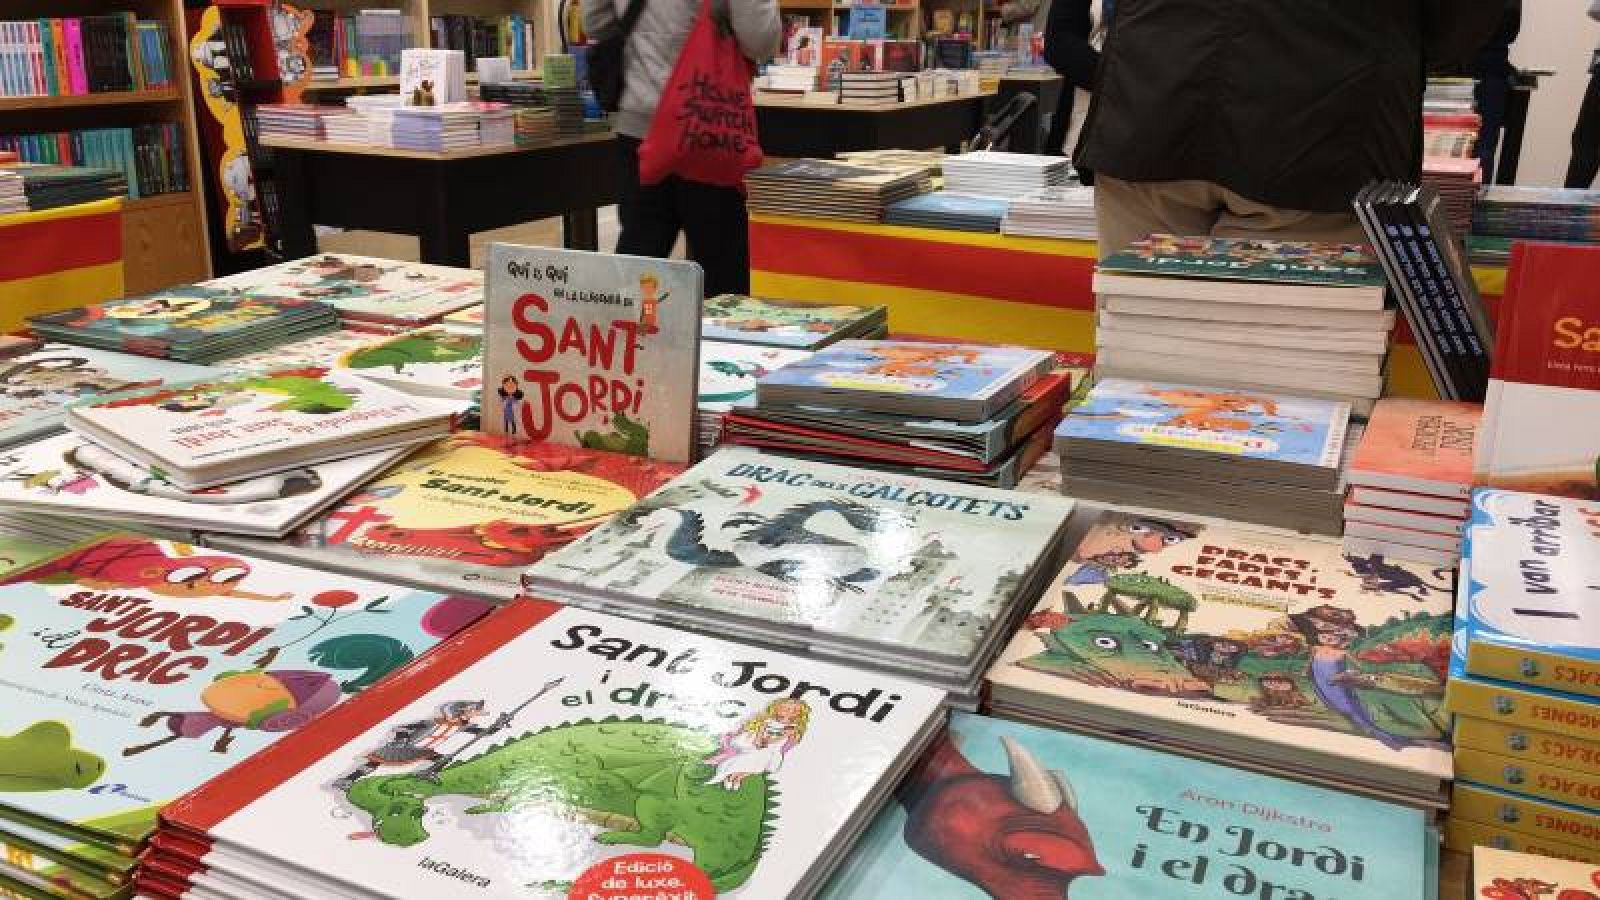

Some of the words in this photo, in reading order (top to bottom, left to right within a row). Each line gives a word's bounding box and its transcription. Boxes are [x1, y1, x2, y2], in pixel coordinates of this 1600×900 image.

[511, 293, 640, 376] SANT
[724, 463, 808, 487] DRAC
[420, 478, 499, 499] Sant
[499, 493, 596, 515] Jordi
[1520, 558, 1560, 594] van
[59, 591, 152, 616] SANT
[86, 607, 275, 657] JORDI
[41, 638, 209, 685] DRAC
[550, 625, 700, 674] Sant
[711, 657, 902, 723] Jordi
[561, 689, 595, 708] el
[609, 682, 747, 720] drc
[1135, 805, 1209, 843] En
[1217, 825, 1364, 881] Jordi
[601, 876, 627, 888] de
[1131, 843, 1148, 869] i
[1161, 855, 1209, 885] el
[1223, 863, 1334, 900] dra
